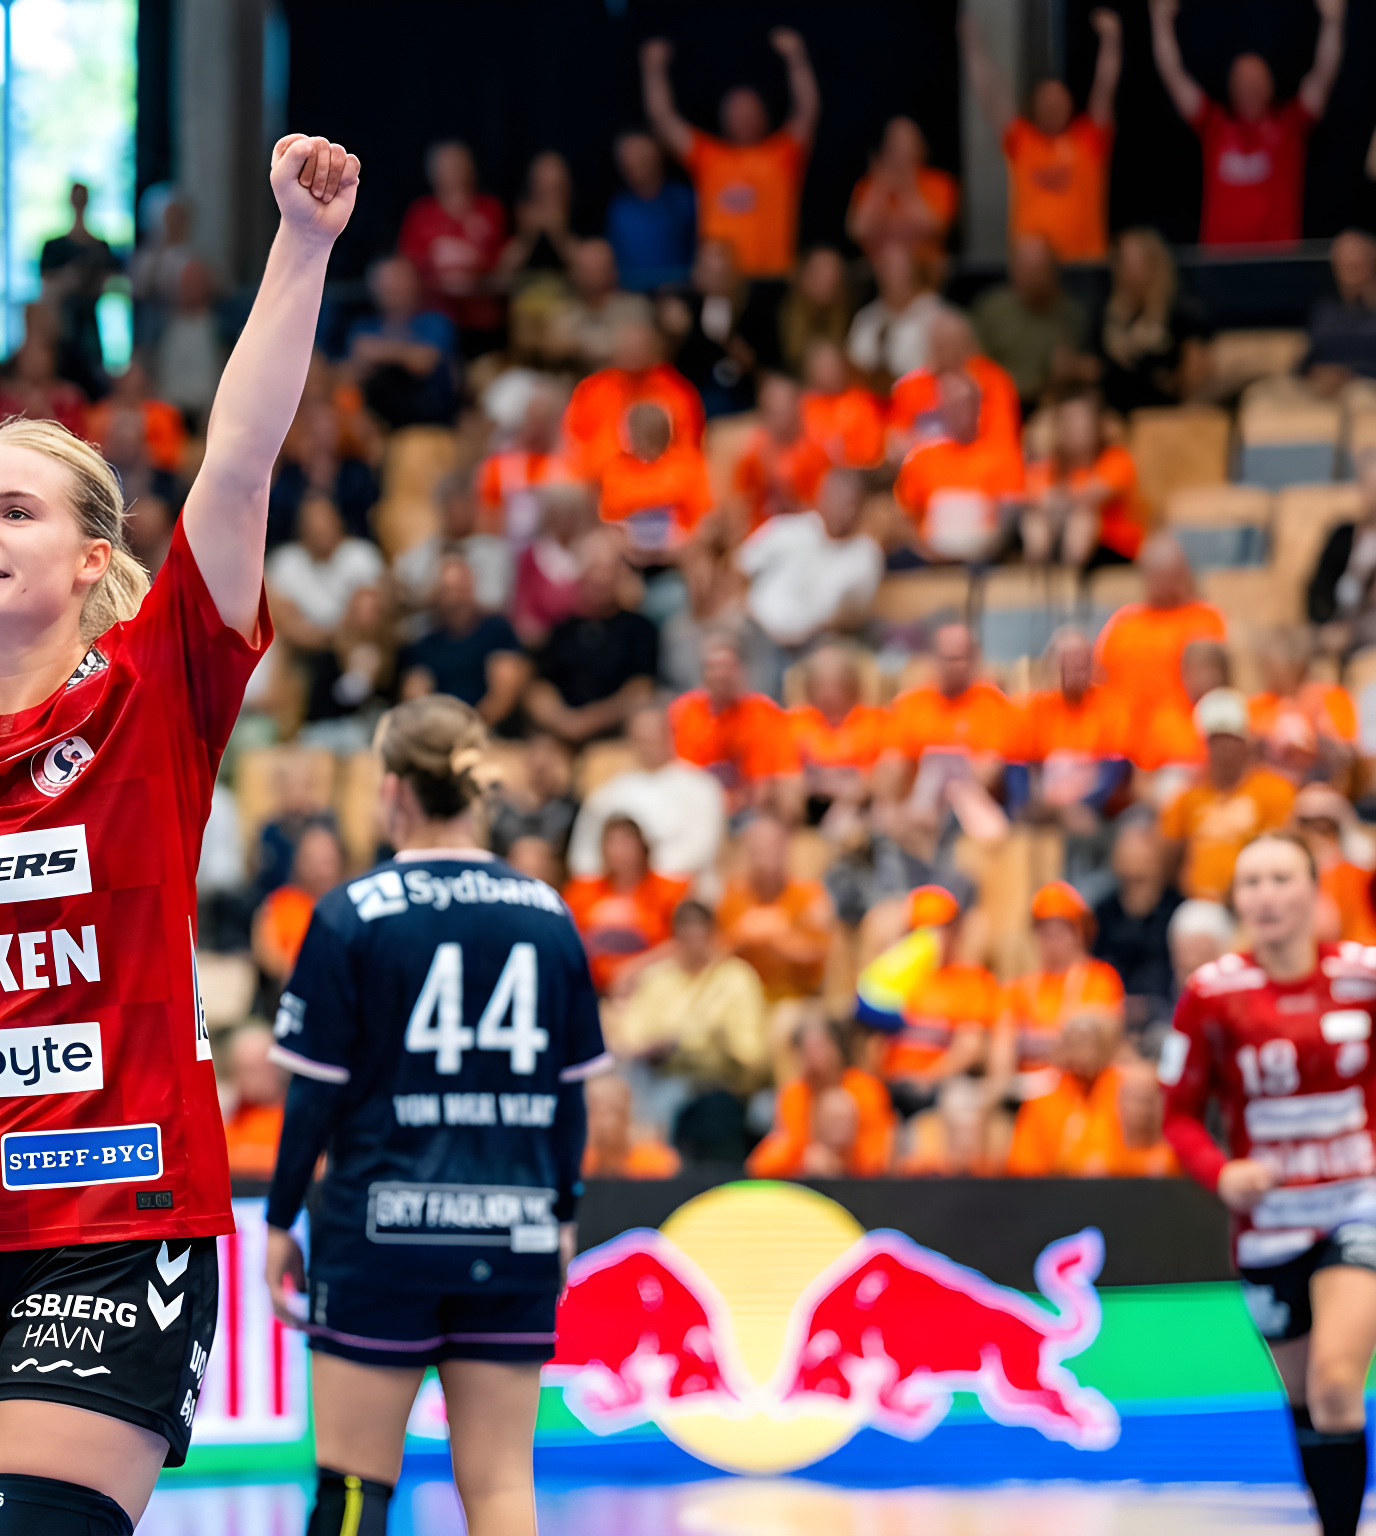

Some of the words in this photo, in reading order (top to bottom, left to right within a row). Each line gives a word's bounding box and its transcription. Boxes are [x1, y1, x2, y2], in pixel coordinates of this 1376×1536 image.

[405, 942, 549, 1075] 44
[8, 1143, 155, 1171] STEFF-BYG
[22, 1322, 105, 1354] HAVN
